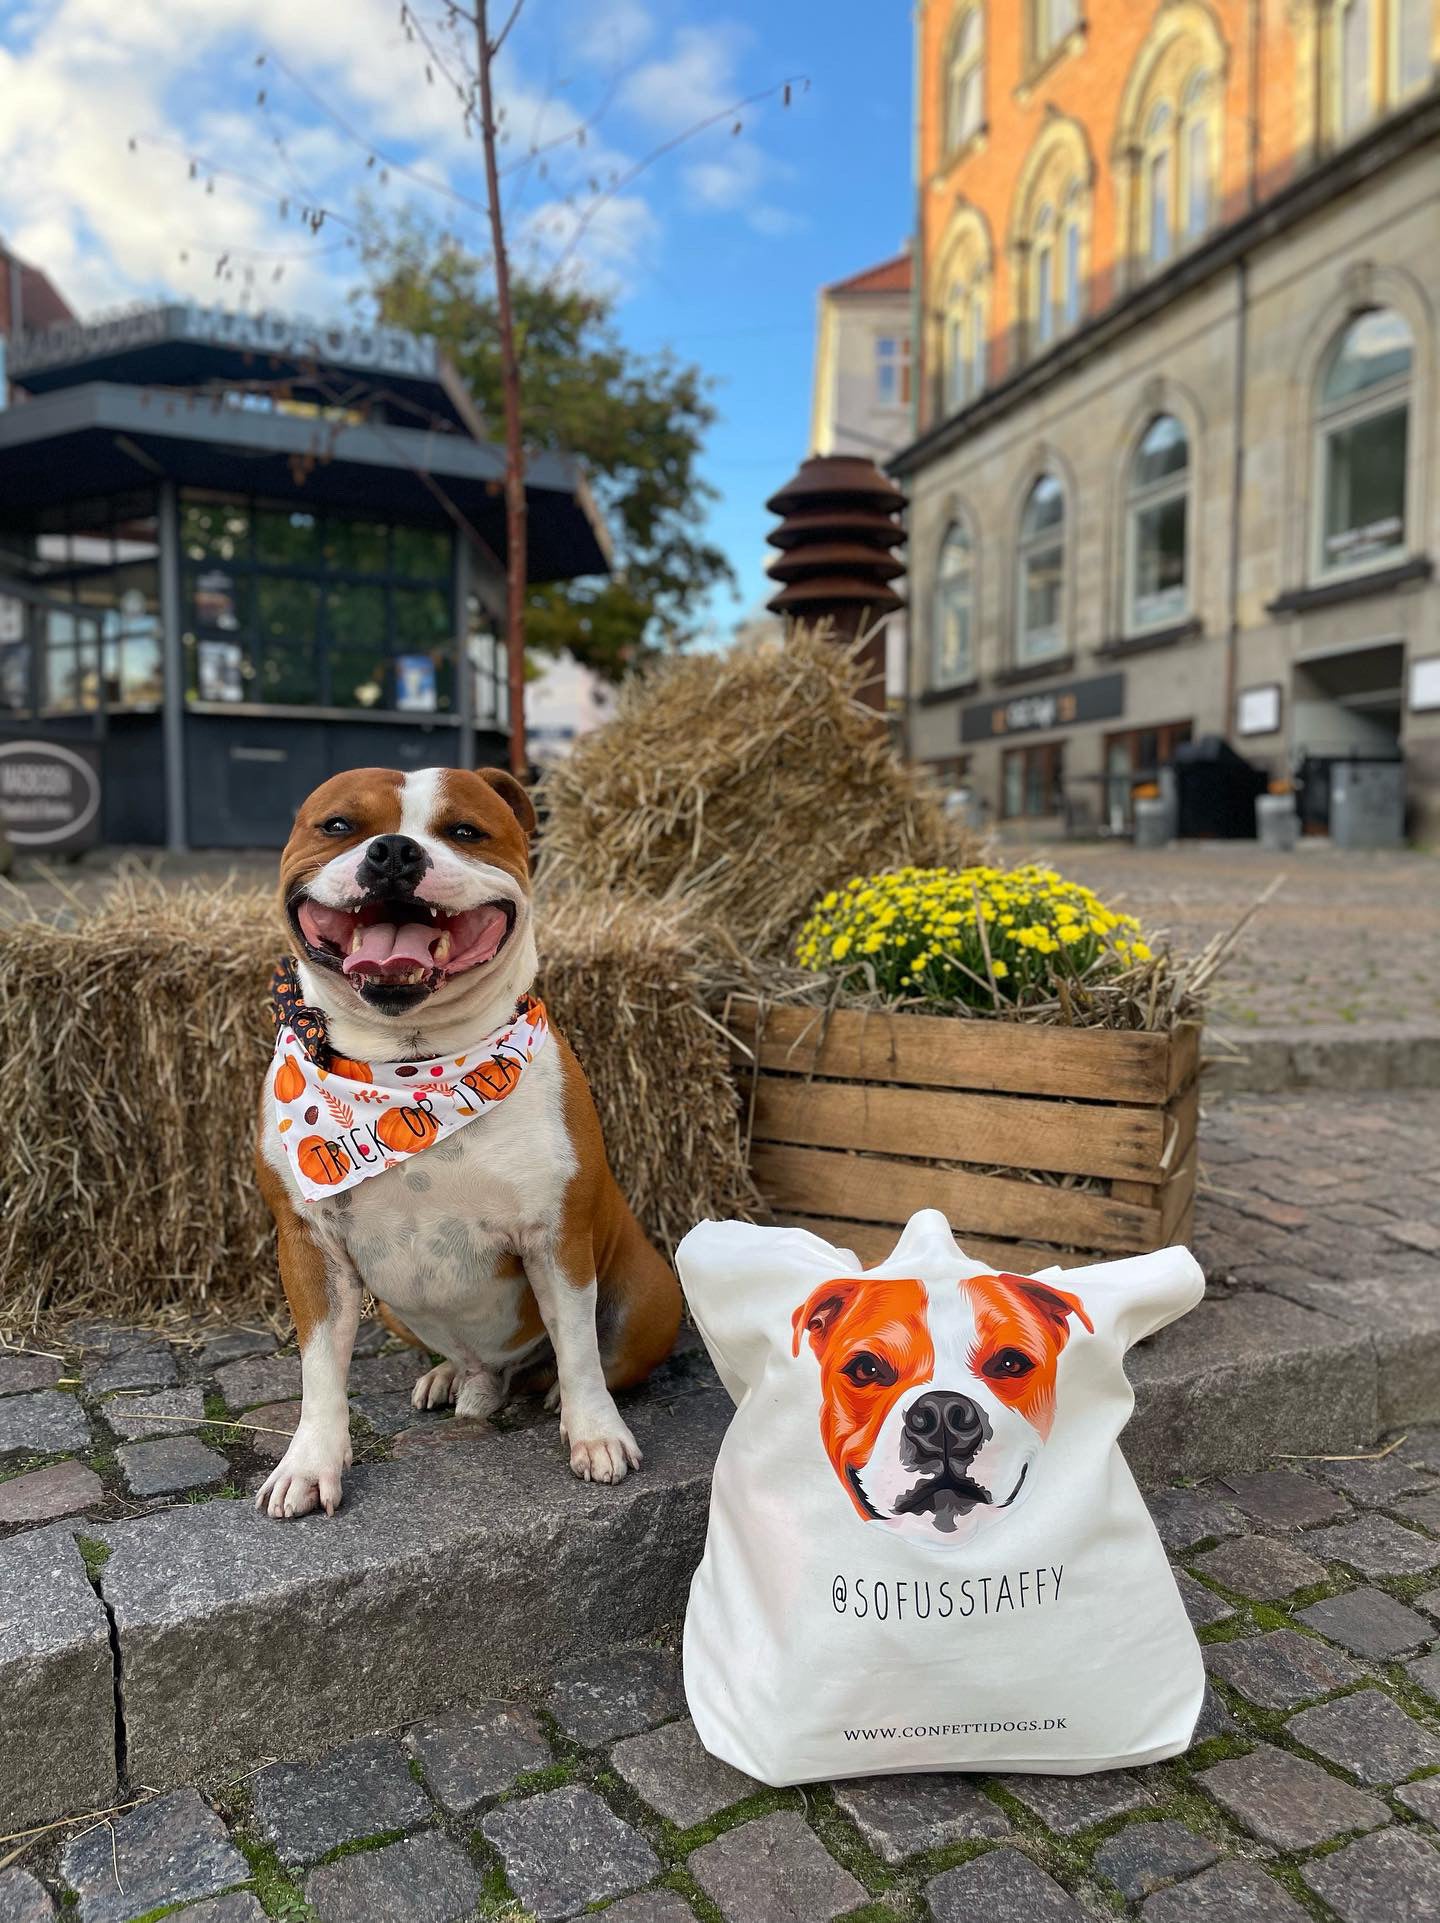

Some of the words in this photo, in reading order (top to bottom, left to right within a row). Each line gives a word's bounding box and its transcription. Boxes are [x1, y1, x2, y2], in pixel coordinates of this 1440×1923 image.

[311, 1119, 394, 1183] TRICK
[399, 1098, 443, 1138] OR
[449, 1039, 528, 1111] TREAT
[832, 1565, 1064, 1621] @SOFUSSTAFFY
[844, 1718, 1067, 1741] WWW.CONFETTIDOGS.DK
